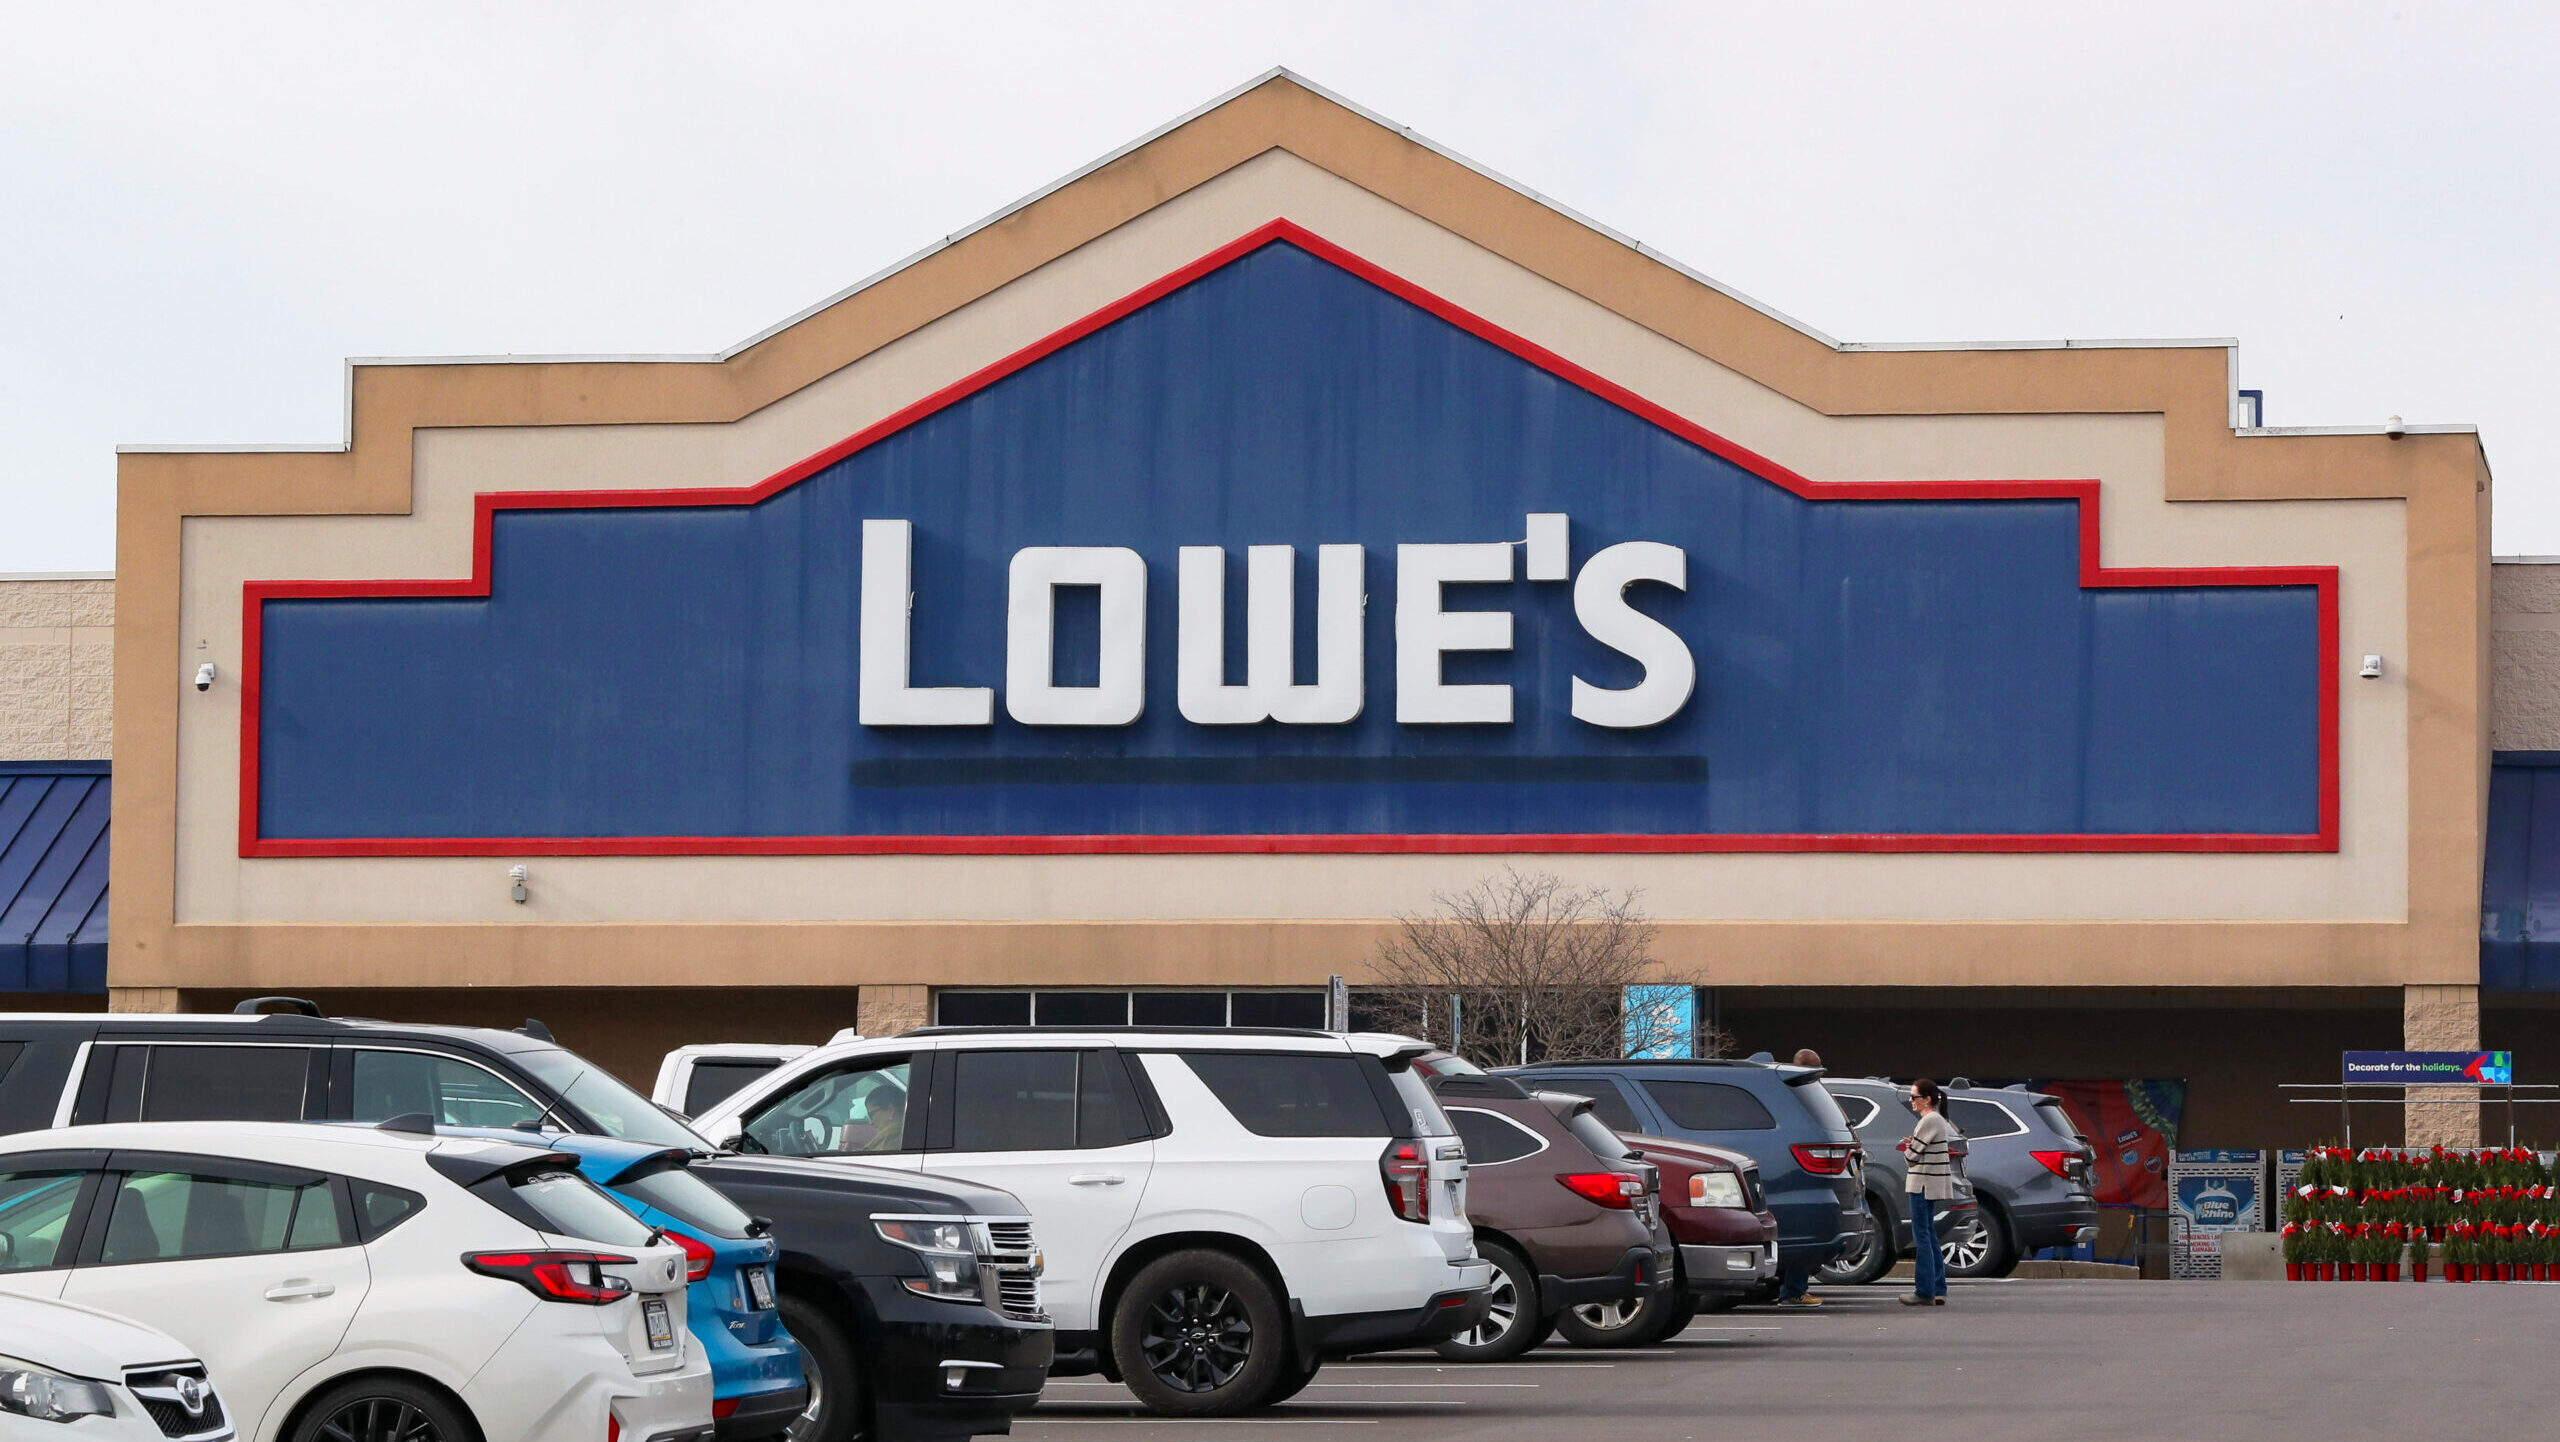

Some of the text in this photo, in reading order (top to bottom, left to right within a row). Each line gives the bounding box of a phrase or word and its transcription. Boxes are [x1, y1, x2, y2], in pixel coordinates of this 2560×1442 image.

[859, 513, 1696, 728] LOWE'S
[2348, 1062, 2463, 1073] Decorate for the holidays.
[2204, 1200, 2230, 1210] Blue
